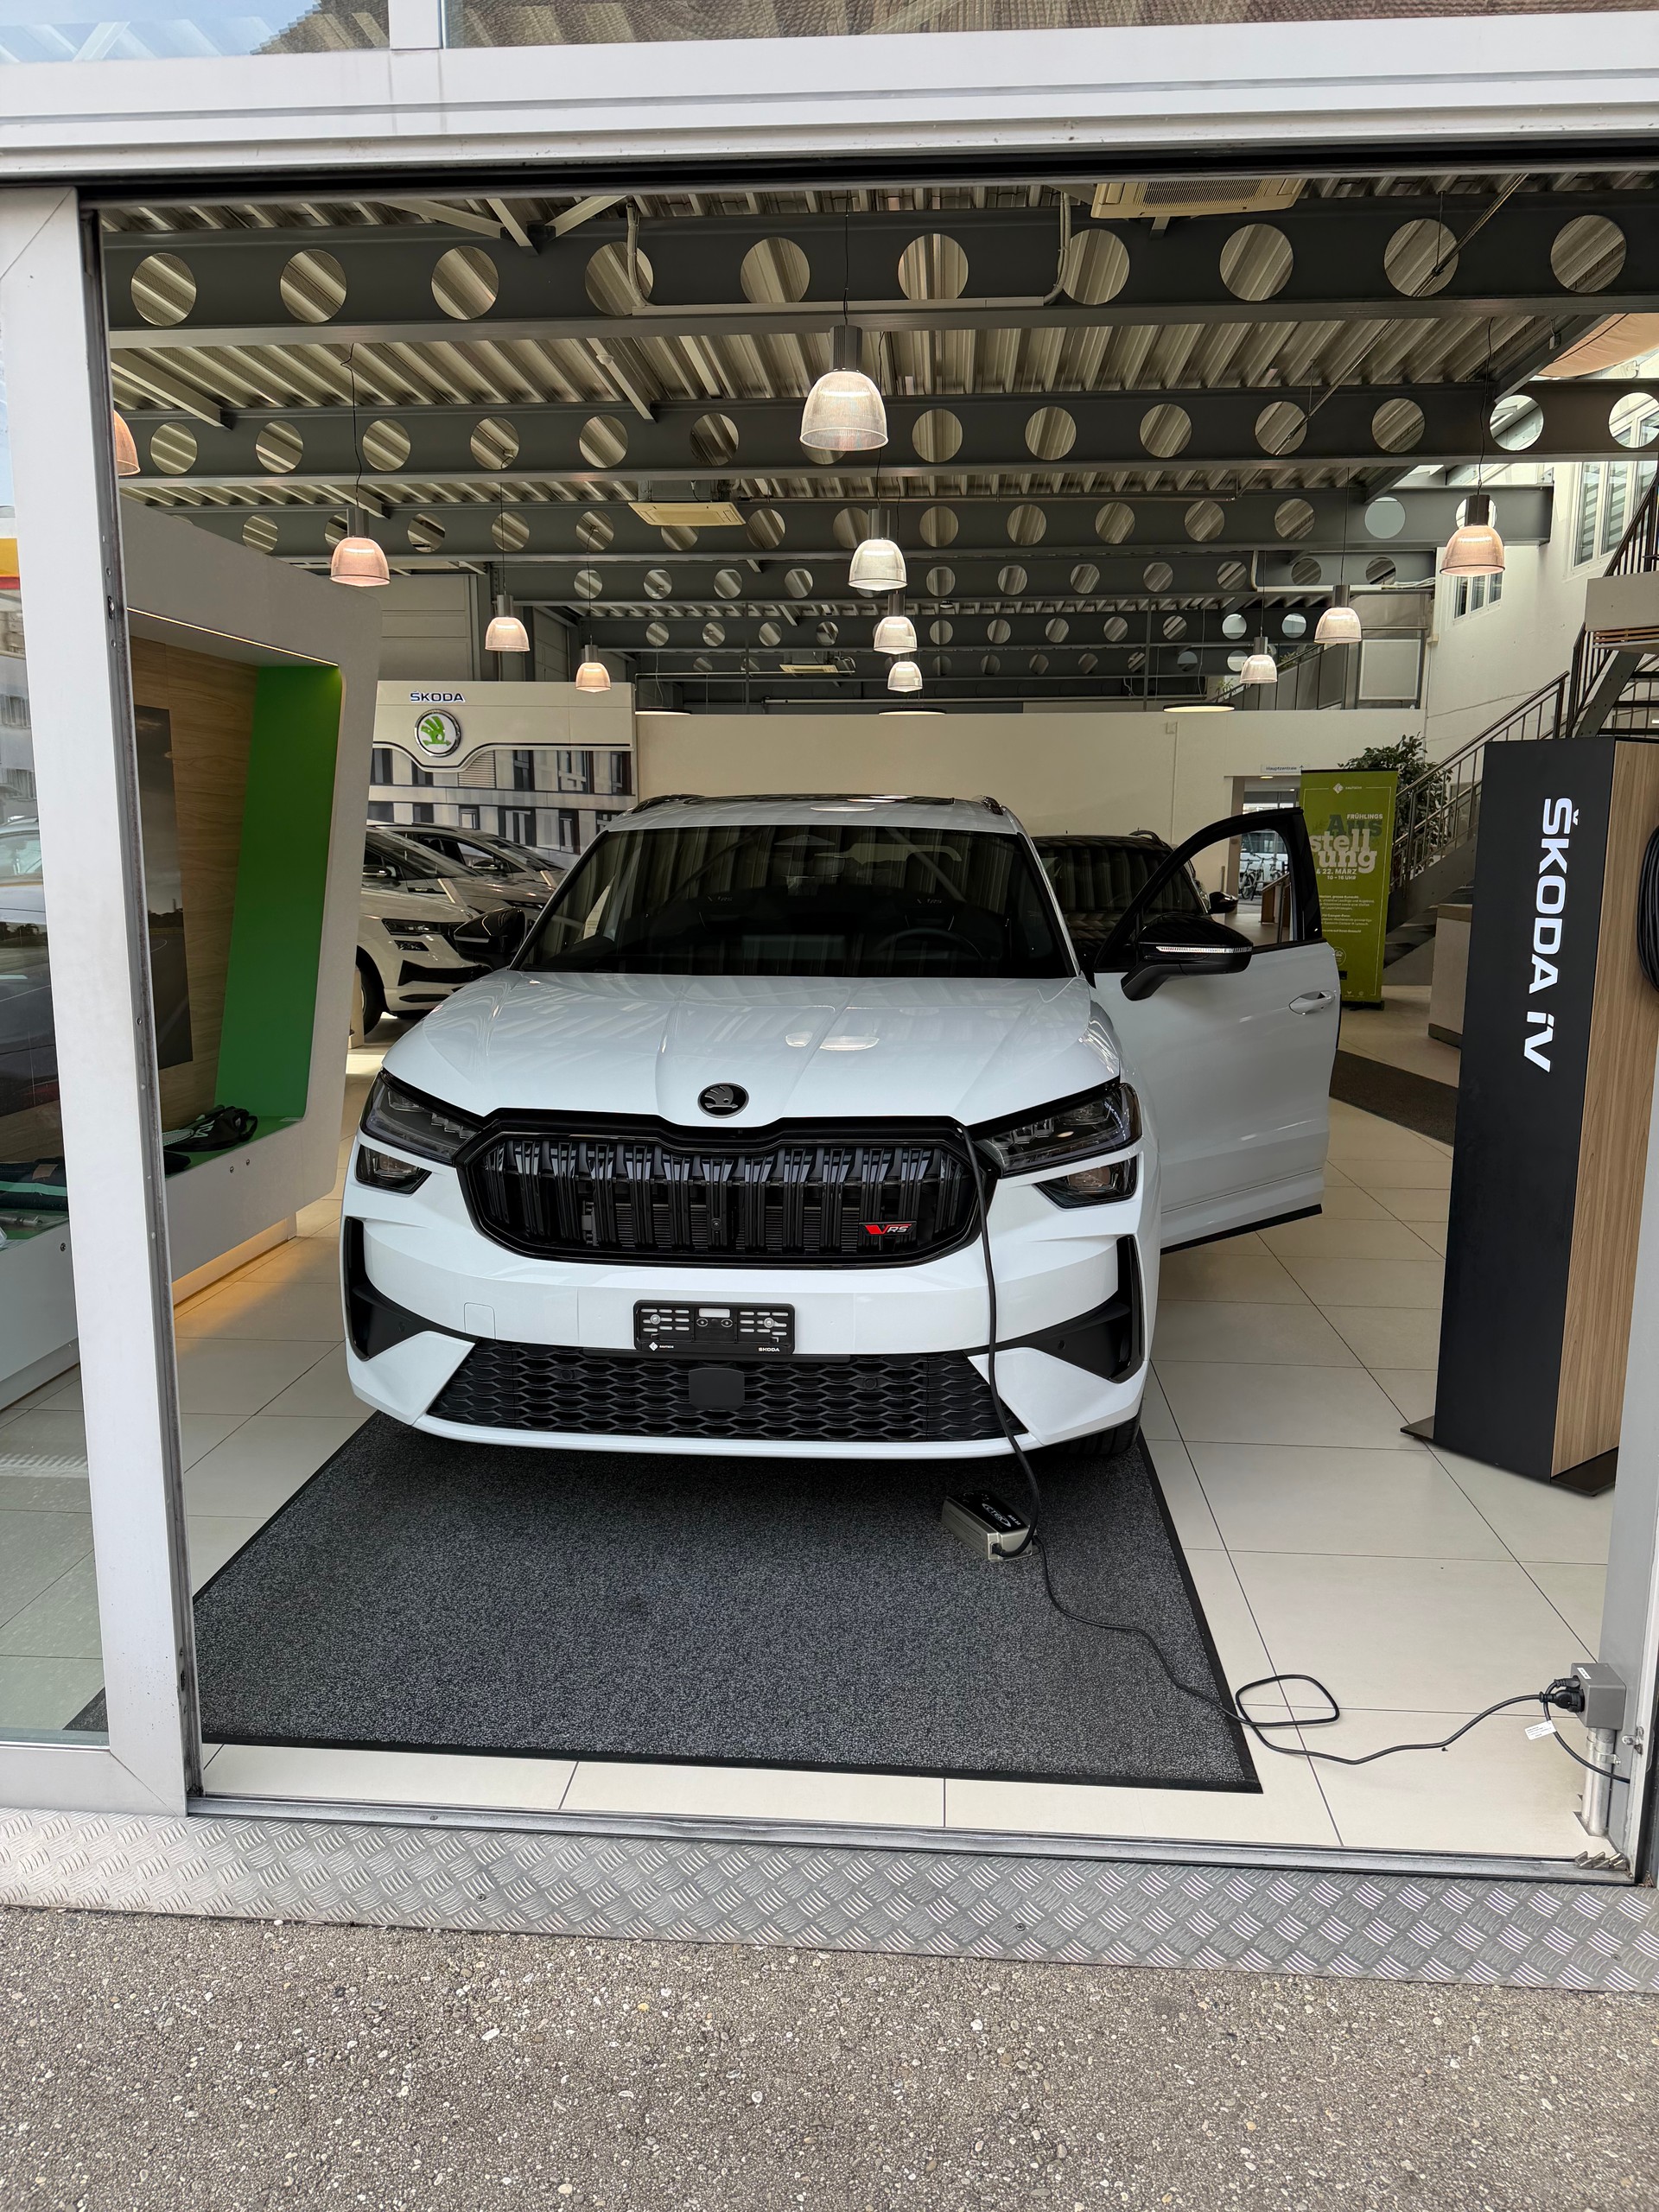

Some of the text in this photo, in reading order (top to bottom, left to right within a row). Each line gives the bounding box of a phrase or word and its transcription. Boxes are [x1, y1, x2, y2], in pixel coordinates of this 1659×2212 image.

[1308, 828, 1370, 853] stell
[1318, 850, 1378, 874] ung
[1529, 798, 1580, 995] ŠKODA
